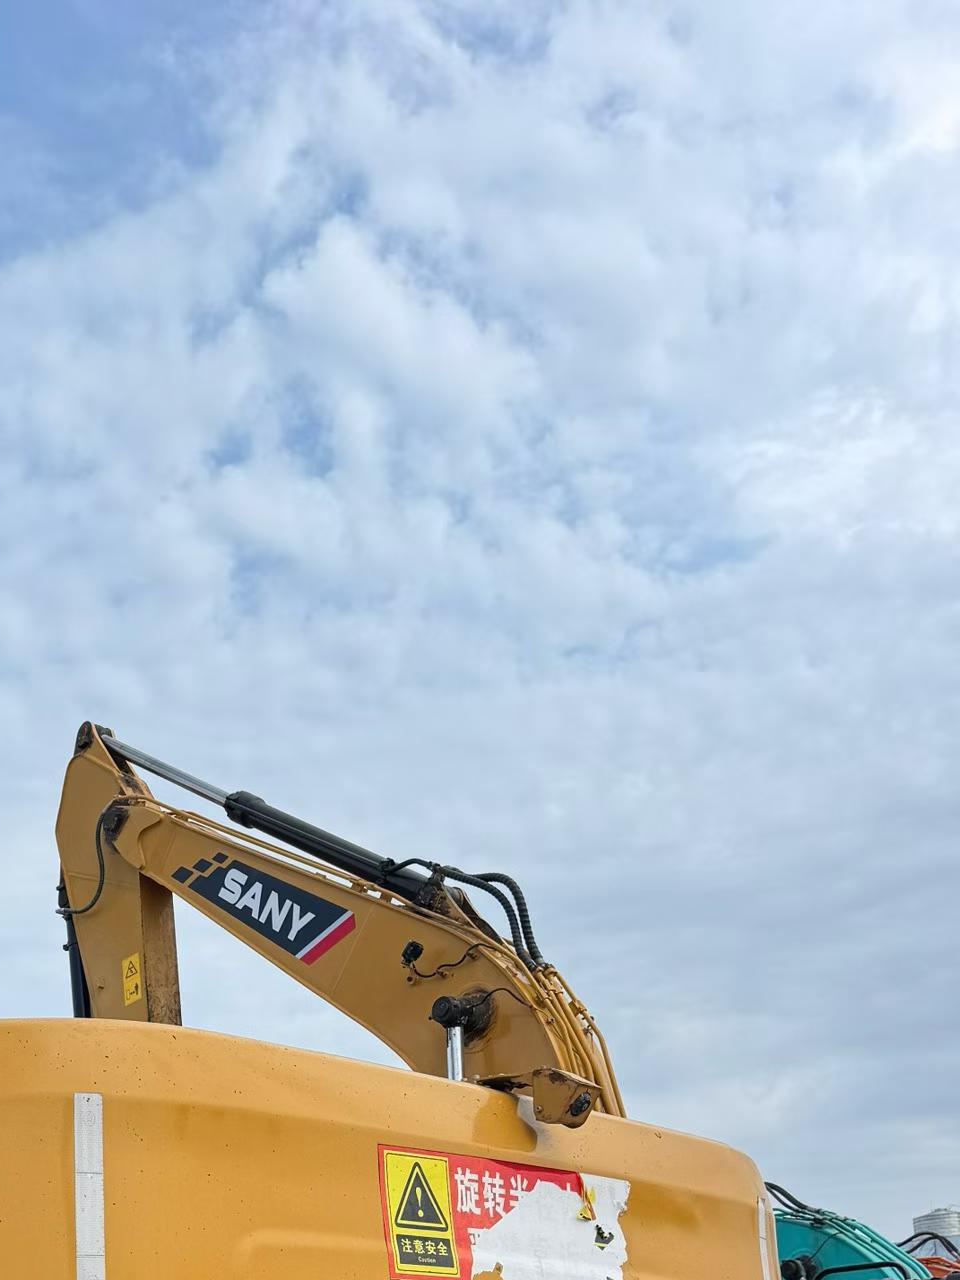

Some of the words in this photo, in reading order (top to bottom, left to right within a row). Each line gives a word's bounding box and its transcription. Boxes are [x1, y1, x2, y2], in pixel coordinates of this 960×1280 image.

[217, 868, 316, 942] SANY
[454, 1167, 571, 1217] 旋转半
[401, 1238, 449, 1256] 注意安全
